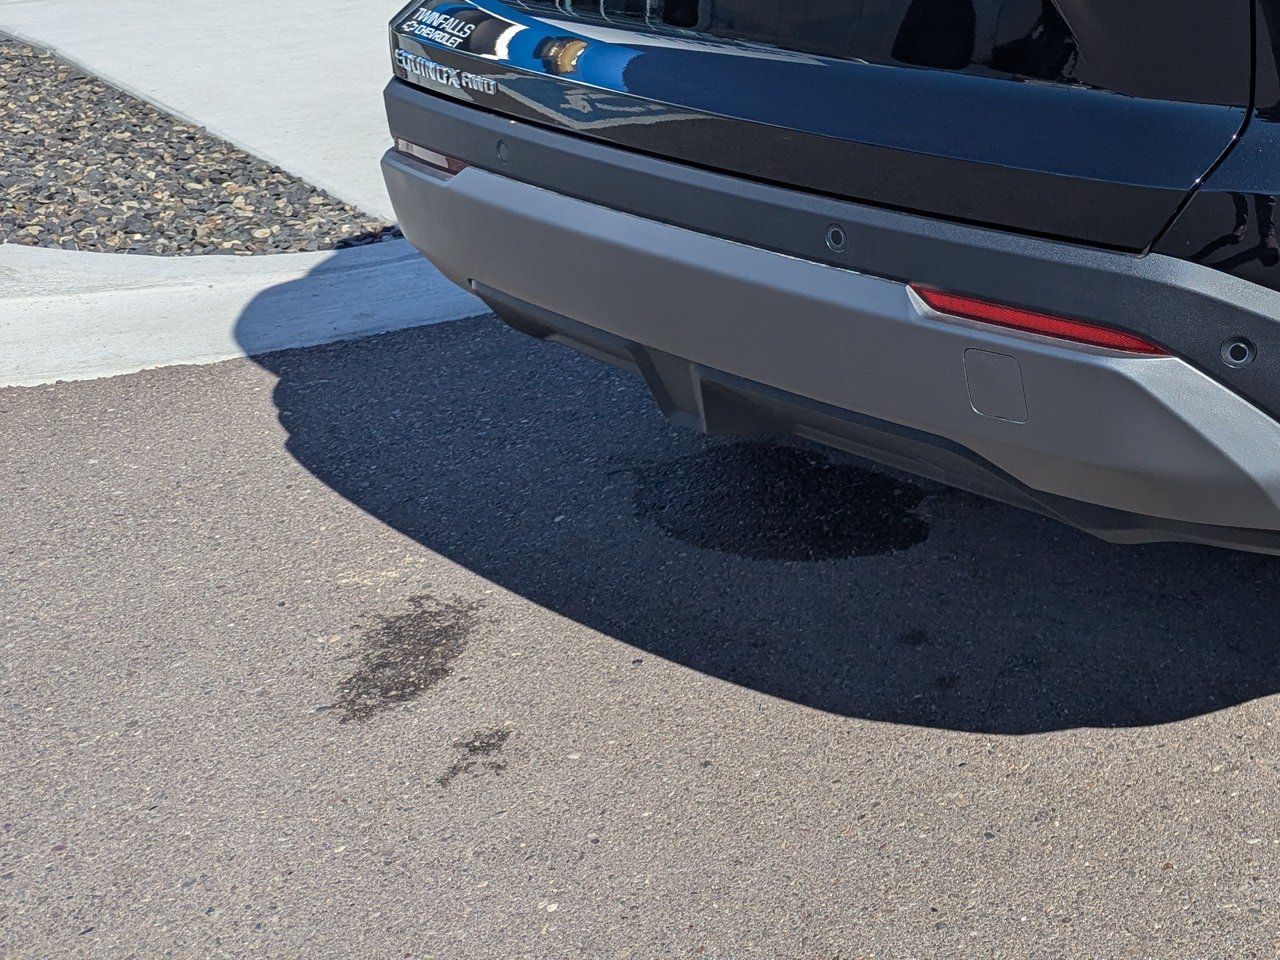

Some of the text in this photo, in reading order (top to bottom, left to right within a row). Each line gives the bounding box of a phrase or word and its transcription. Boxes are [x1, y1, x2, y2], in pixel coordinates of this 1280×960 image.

[412, 7, 476, 38] TWINFALLS
[414, 22, 464, 48] CHEVROLET
[394, 48, 498, 95] EQUINOX AWD
